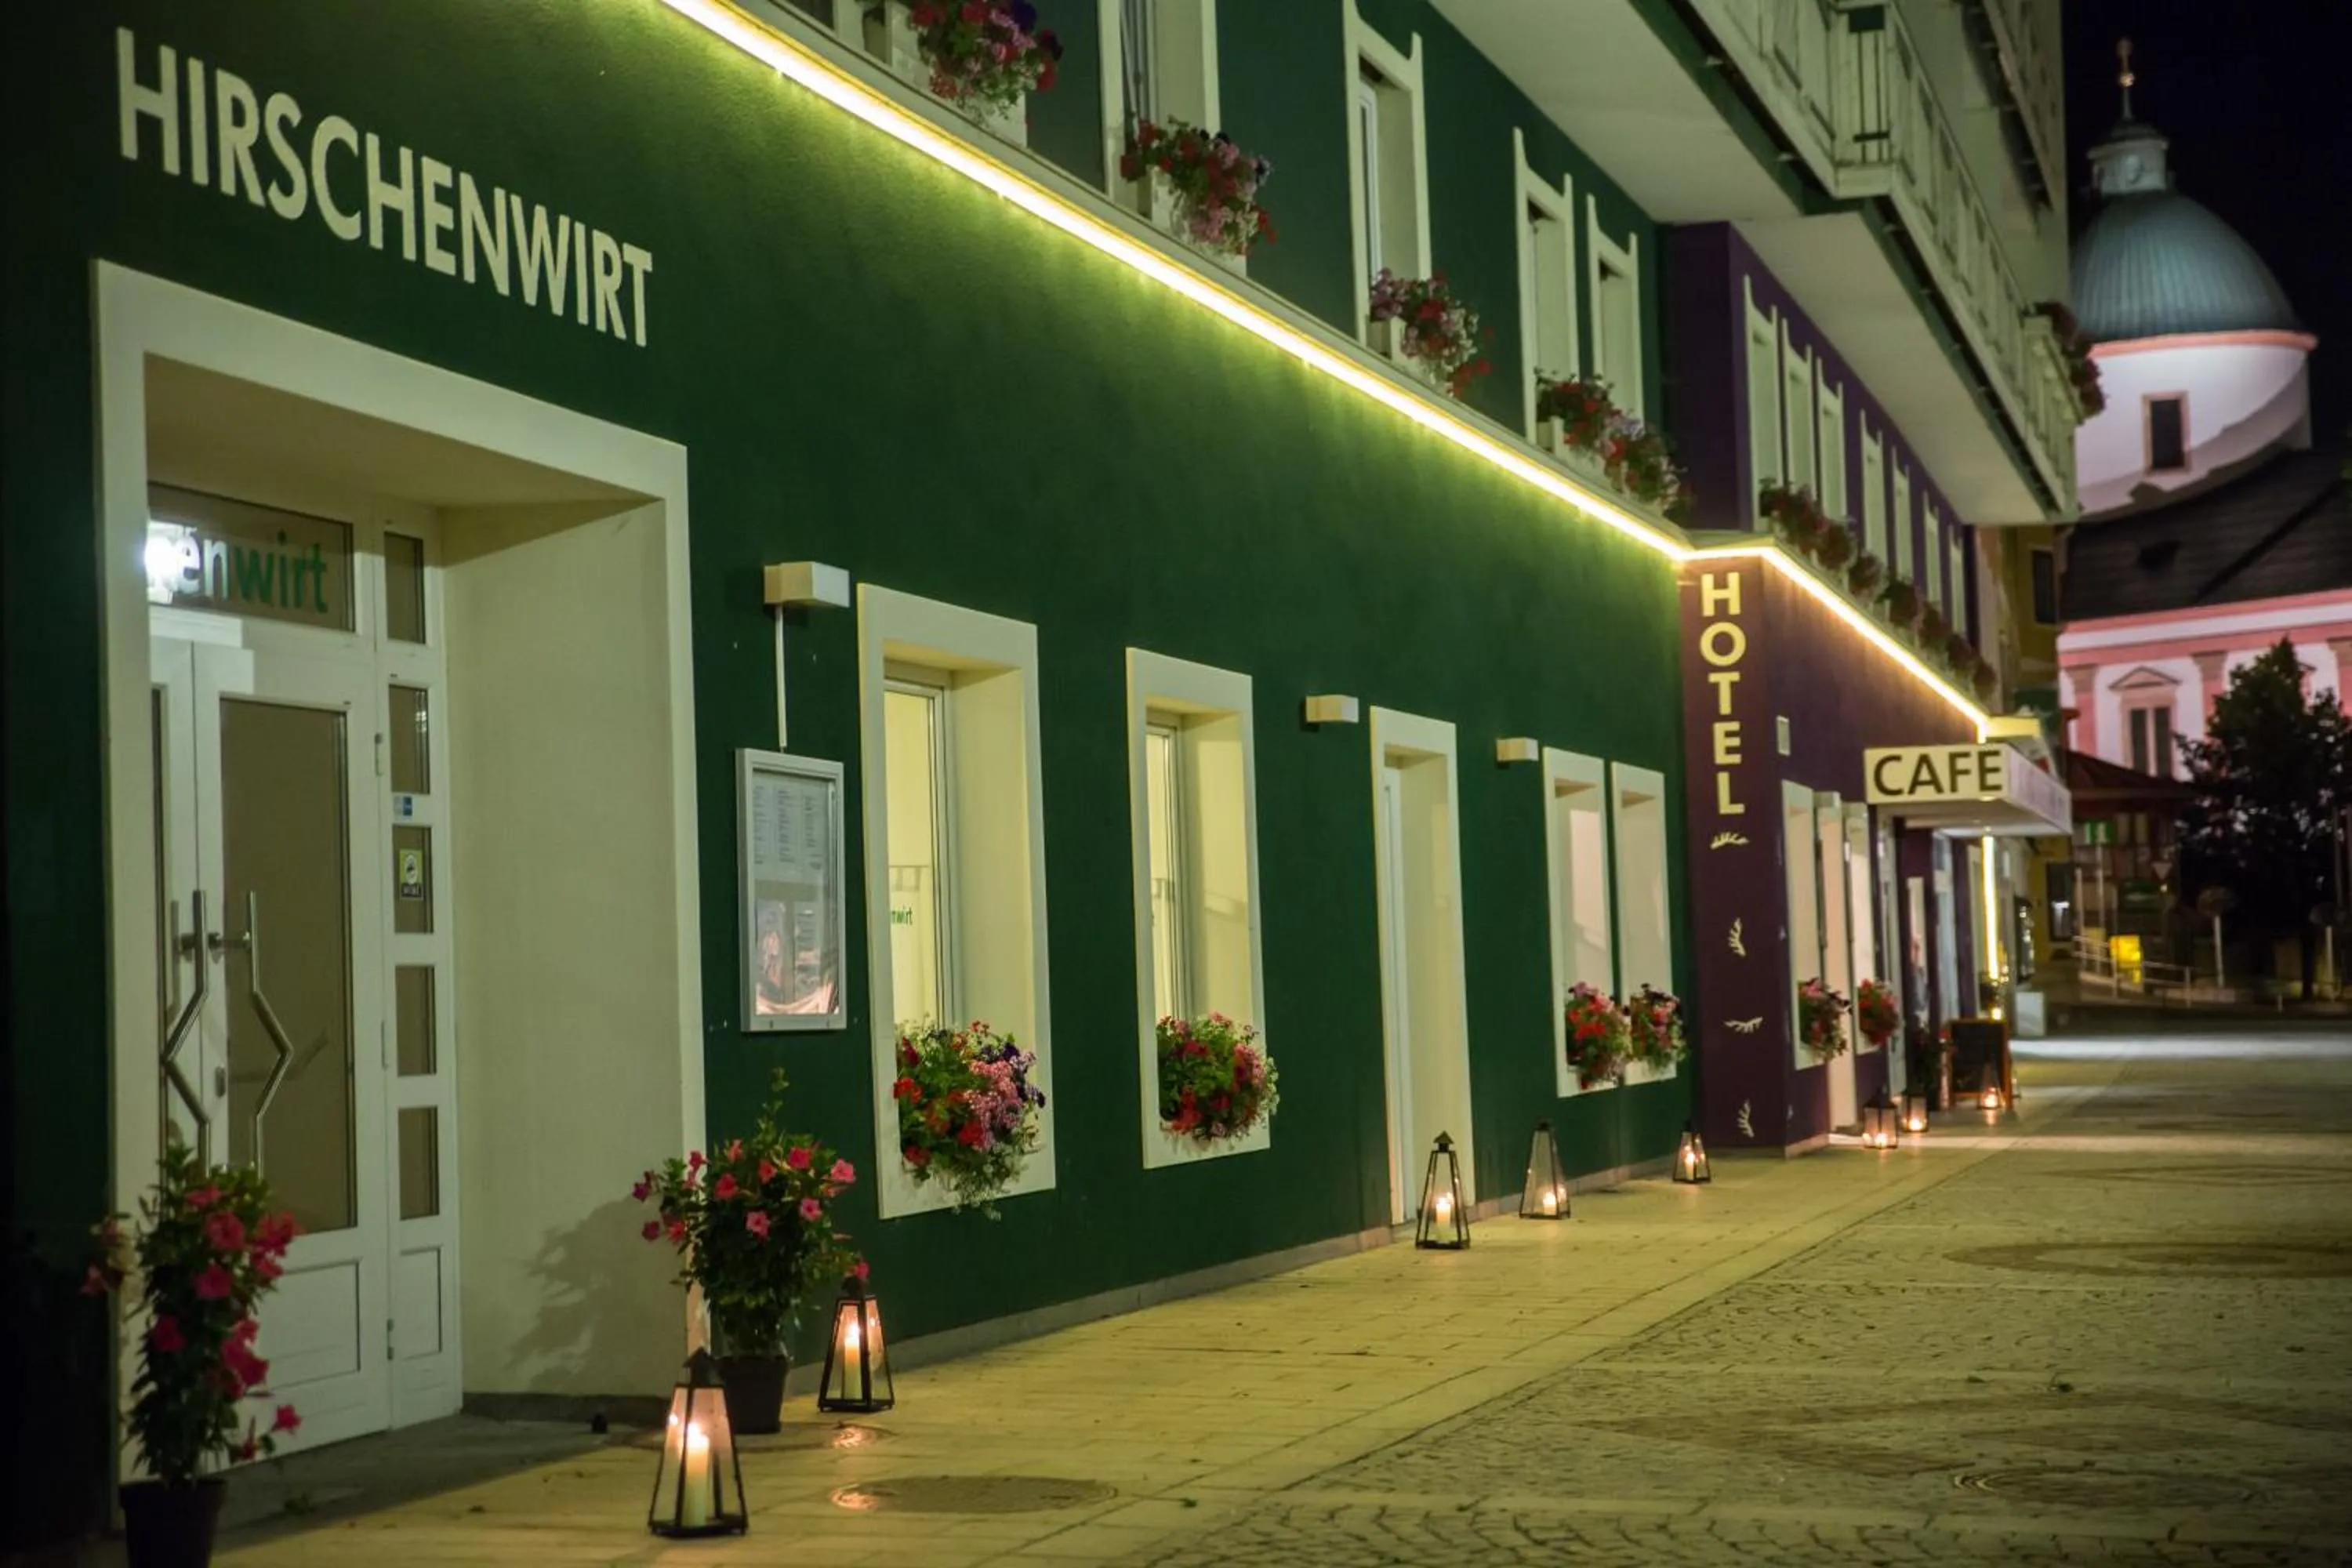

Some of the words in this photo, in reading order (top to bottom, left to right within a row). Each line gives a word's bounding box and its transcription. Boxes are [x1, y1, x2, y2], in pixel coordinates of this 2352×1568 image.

[117, 26, 652, 347] HIRSCHENWIRT
[1700, 572, 1747, 815] HOTEL
[1873, 750, 2003, 797] CAFE
